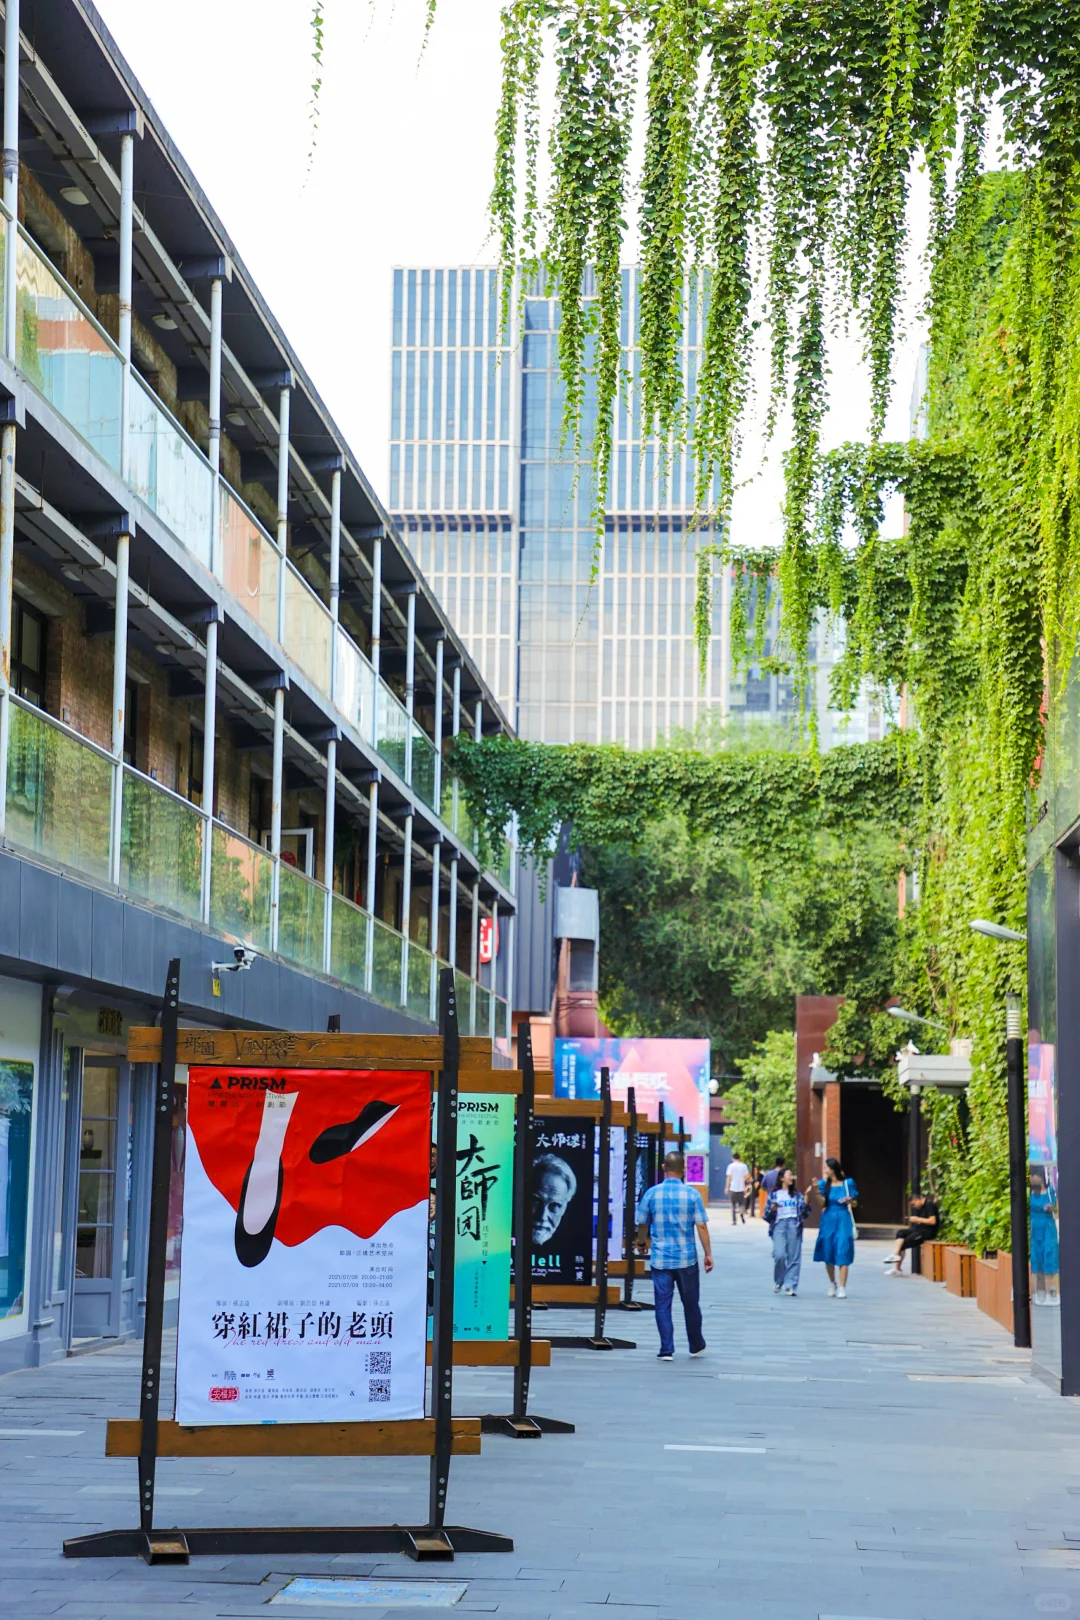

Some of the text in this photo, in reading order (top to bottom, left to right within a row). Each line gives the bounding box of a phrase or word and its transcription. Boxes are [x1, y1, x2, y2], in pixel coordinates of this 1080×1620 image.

[227, 1076, 287, 1091] PRISM
[458, 1101, 499, 1112] PRISM
[535, 1132, 581, 1148] 大师课
[211, 1311, 394, 1340] 穿紅裙子的老頭
[307, 1331, 333, 1346] and
